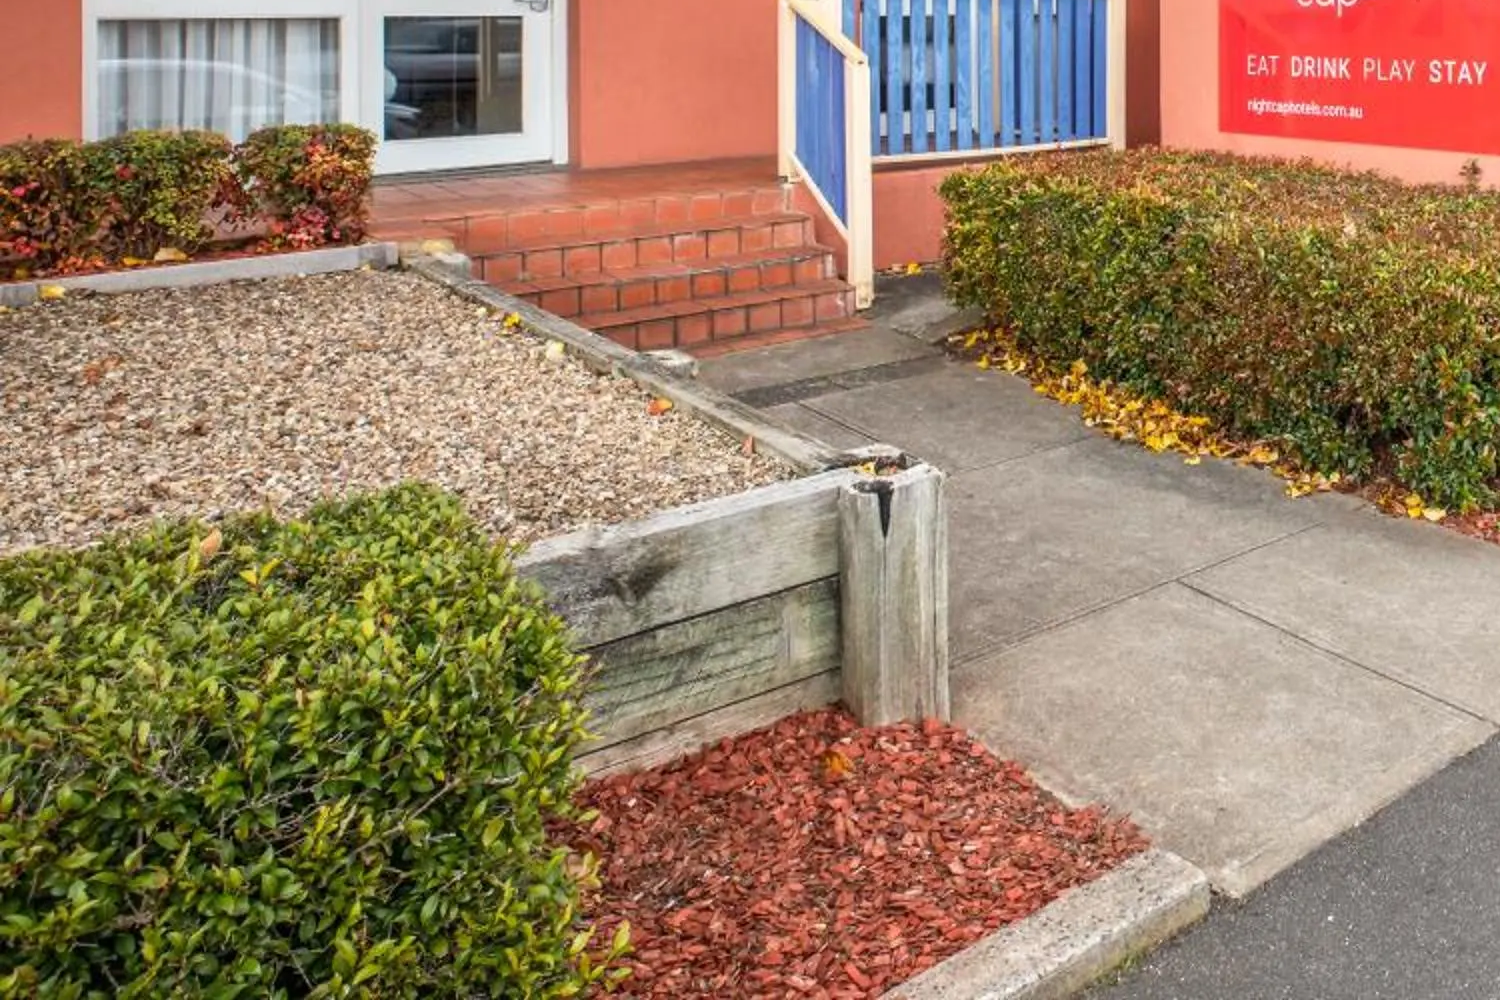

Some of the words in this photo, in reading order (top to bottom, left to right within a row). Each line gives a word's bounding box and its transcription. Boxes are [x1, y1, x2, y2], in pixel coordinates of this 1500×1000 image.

[1247, 54, 1279, 76] EAT
[1291, 55, 1351, 80] DRINK
[1363, 57, 1415, 82] PLAY
[1428, 59, 1488, 85] STAY
[1247, 98, 1364, 119] nightcaphotels.com.au
